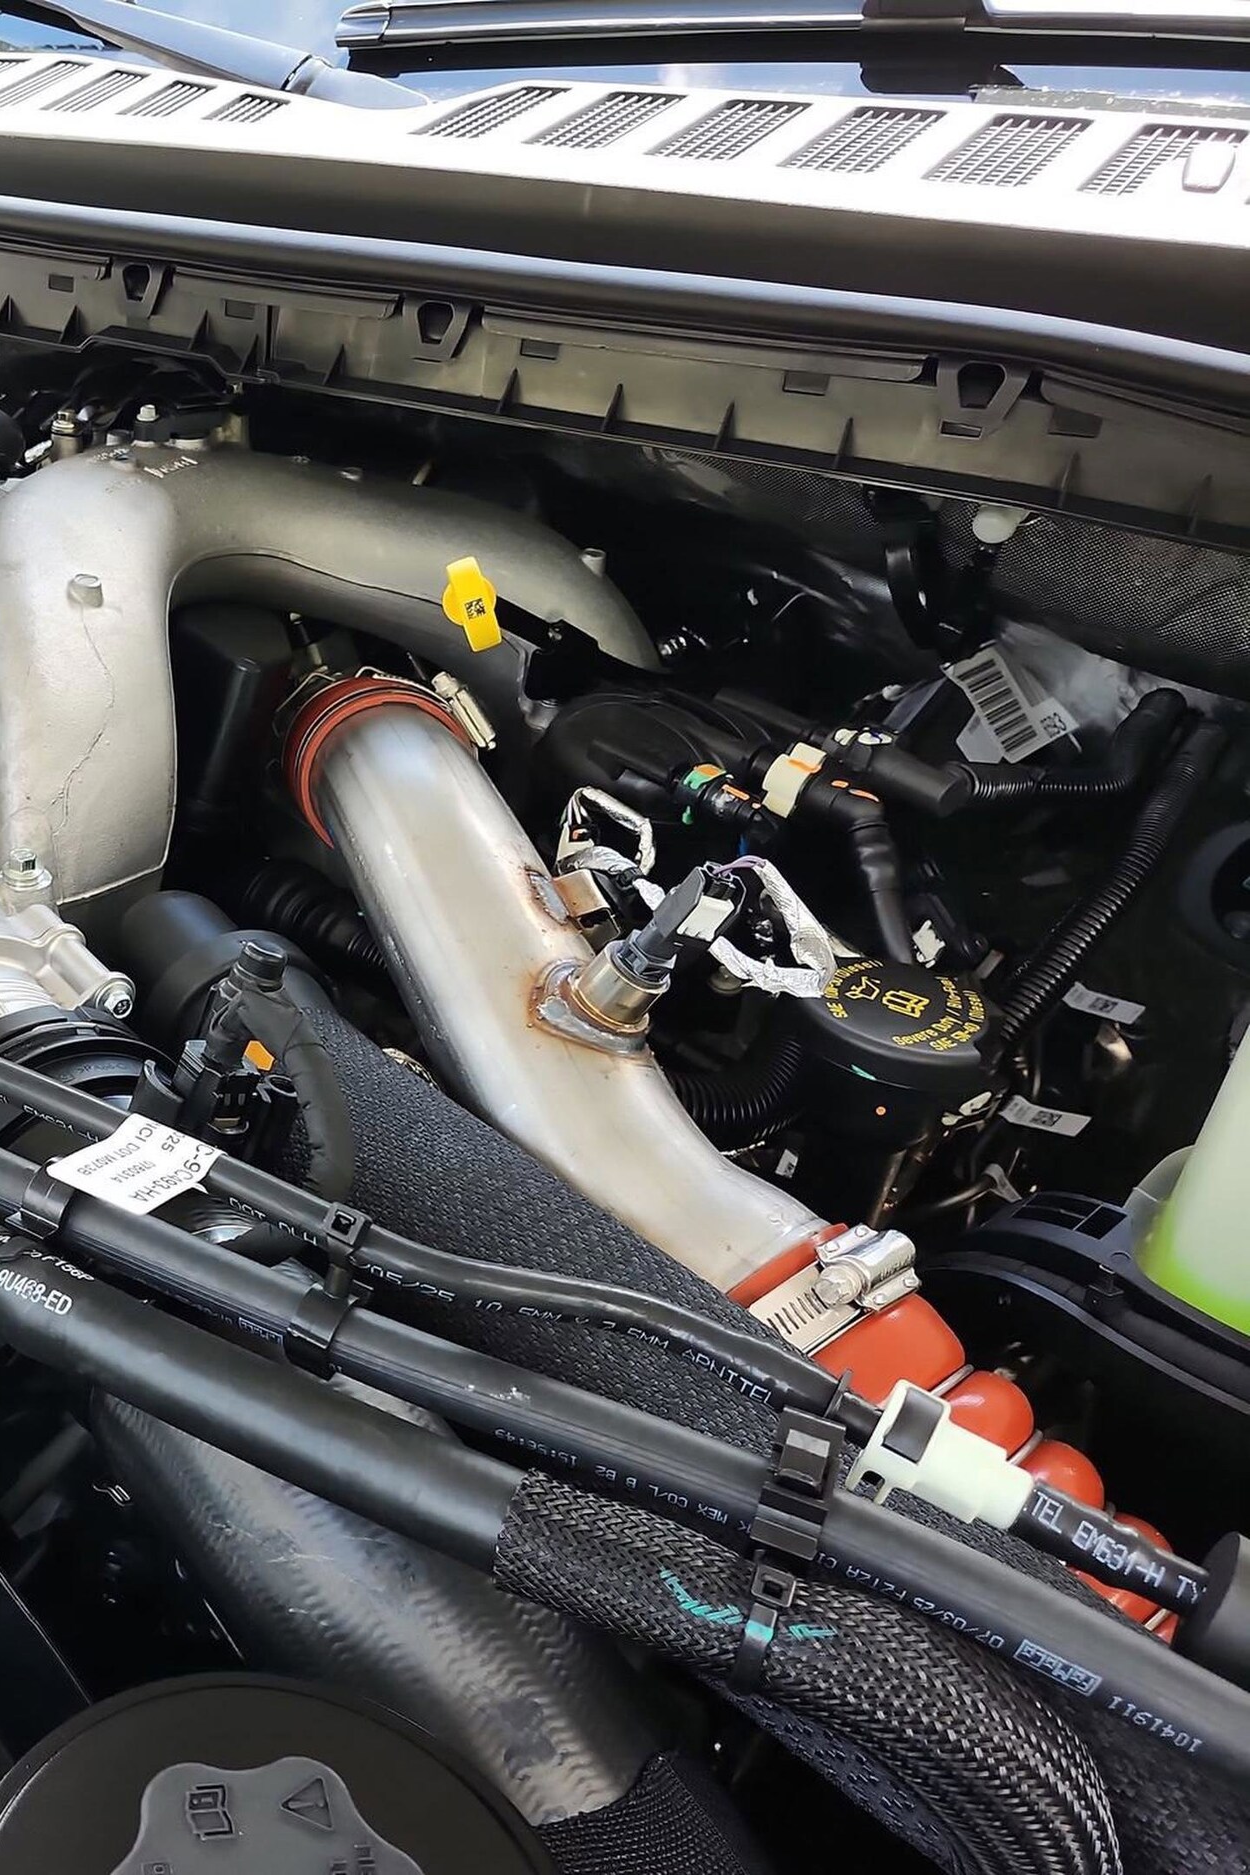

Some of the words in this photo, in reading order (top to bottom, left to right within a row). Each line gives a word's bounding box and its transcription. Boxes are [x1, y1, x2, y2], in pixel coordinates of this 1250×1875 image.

[892, 1027, 939, 1046] Severe
[929, 1037, 958, 1051] SAE
[913, 1596, 1005, 1650] 07/03/25
[1016, 1642, 1100, 1694] FoMoCo
[1108, 1694, 1203, 1754] 1041911
